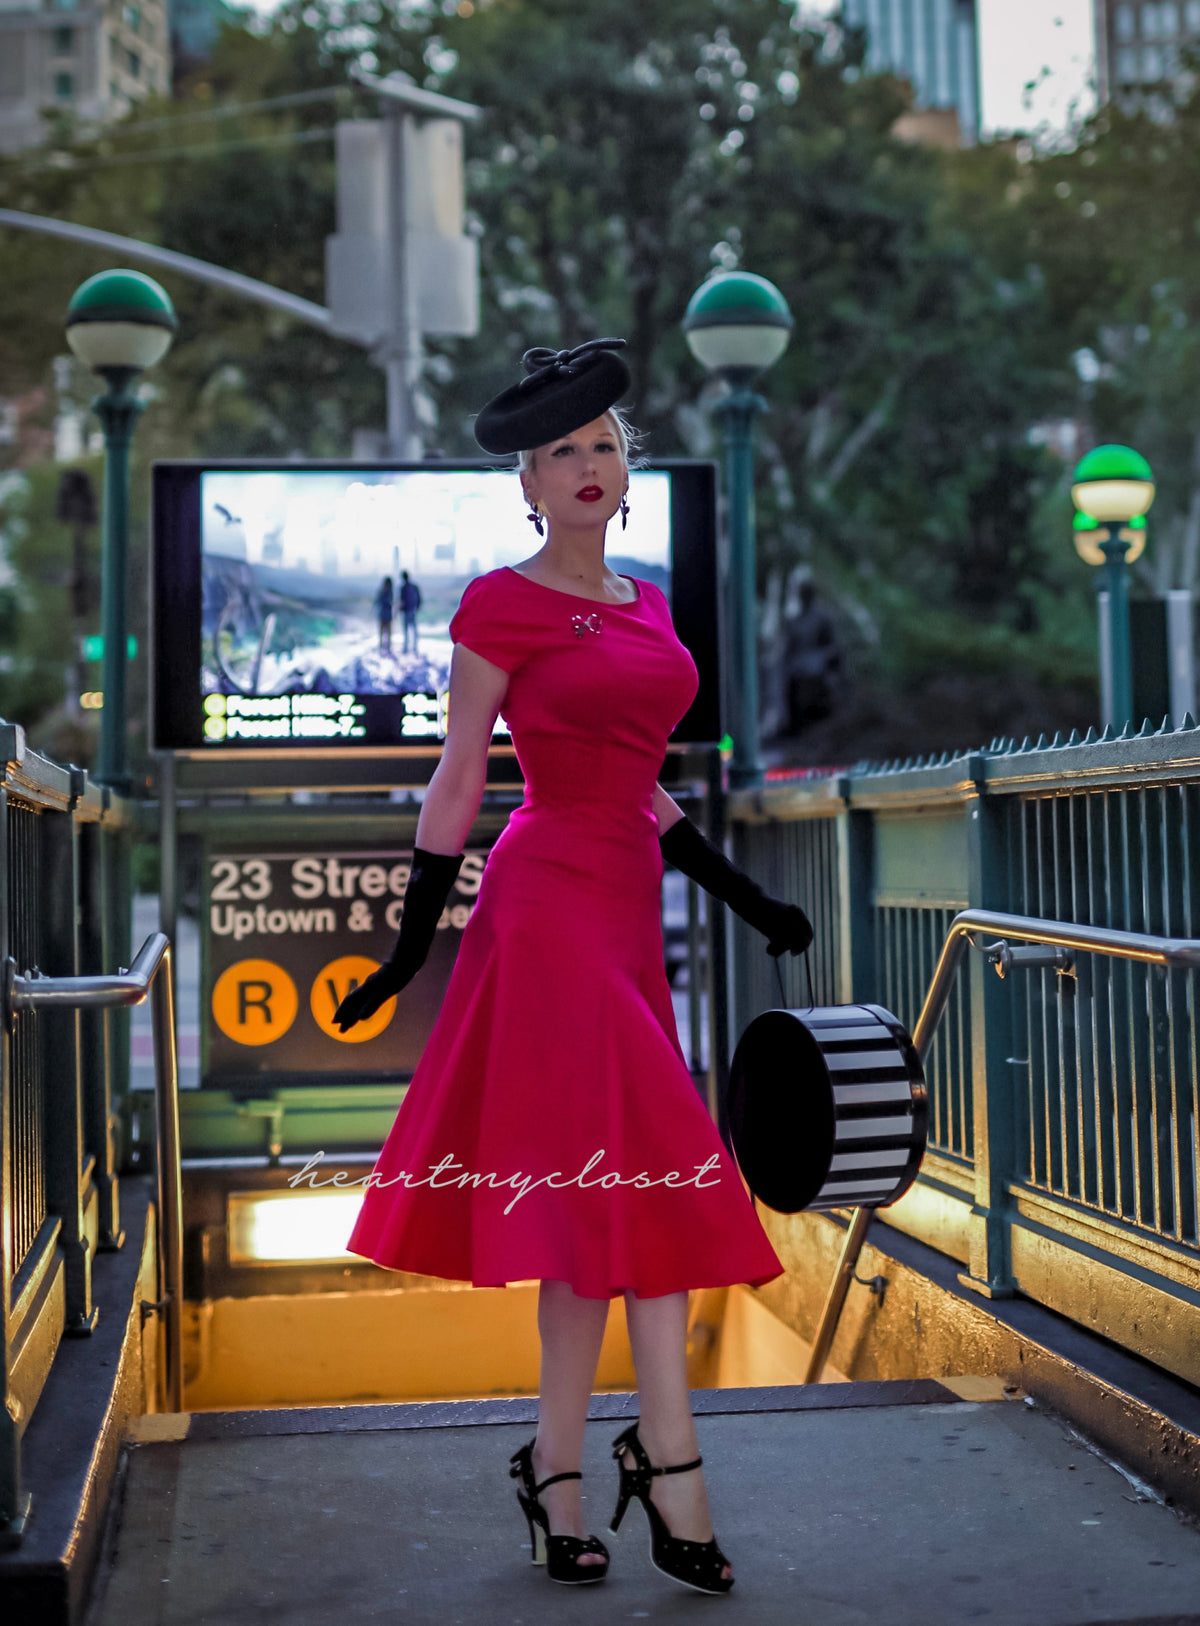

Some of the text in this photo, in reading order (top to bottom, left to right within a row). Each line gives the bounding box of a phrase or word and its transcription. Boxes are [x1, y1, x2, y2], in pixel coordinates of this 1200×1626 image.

[210, 859, 272, 899] 23
[290, 857, 411, 898] Stree
[210, 904, 336, 940] Uptown
[347, 900, 374, 932] &
[237, 980, 273, 1025] R
